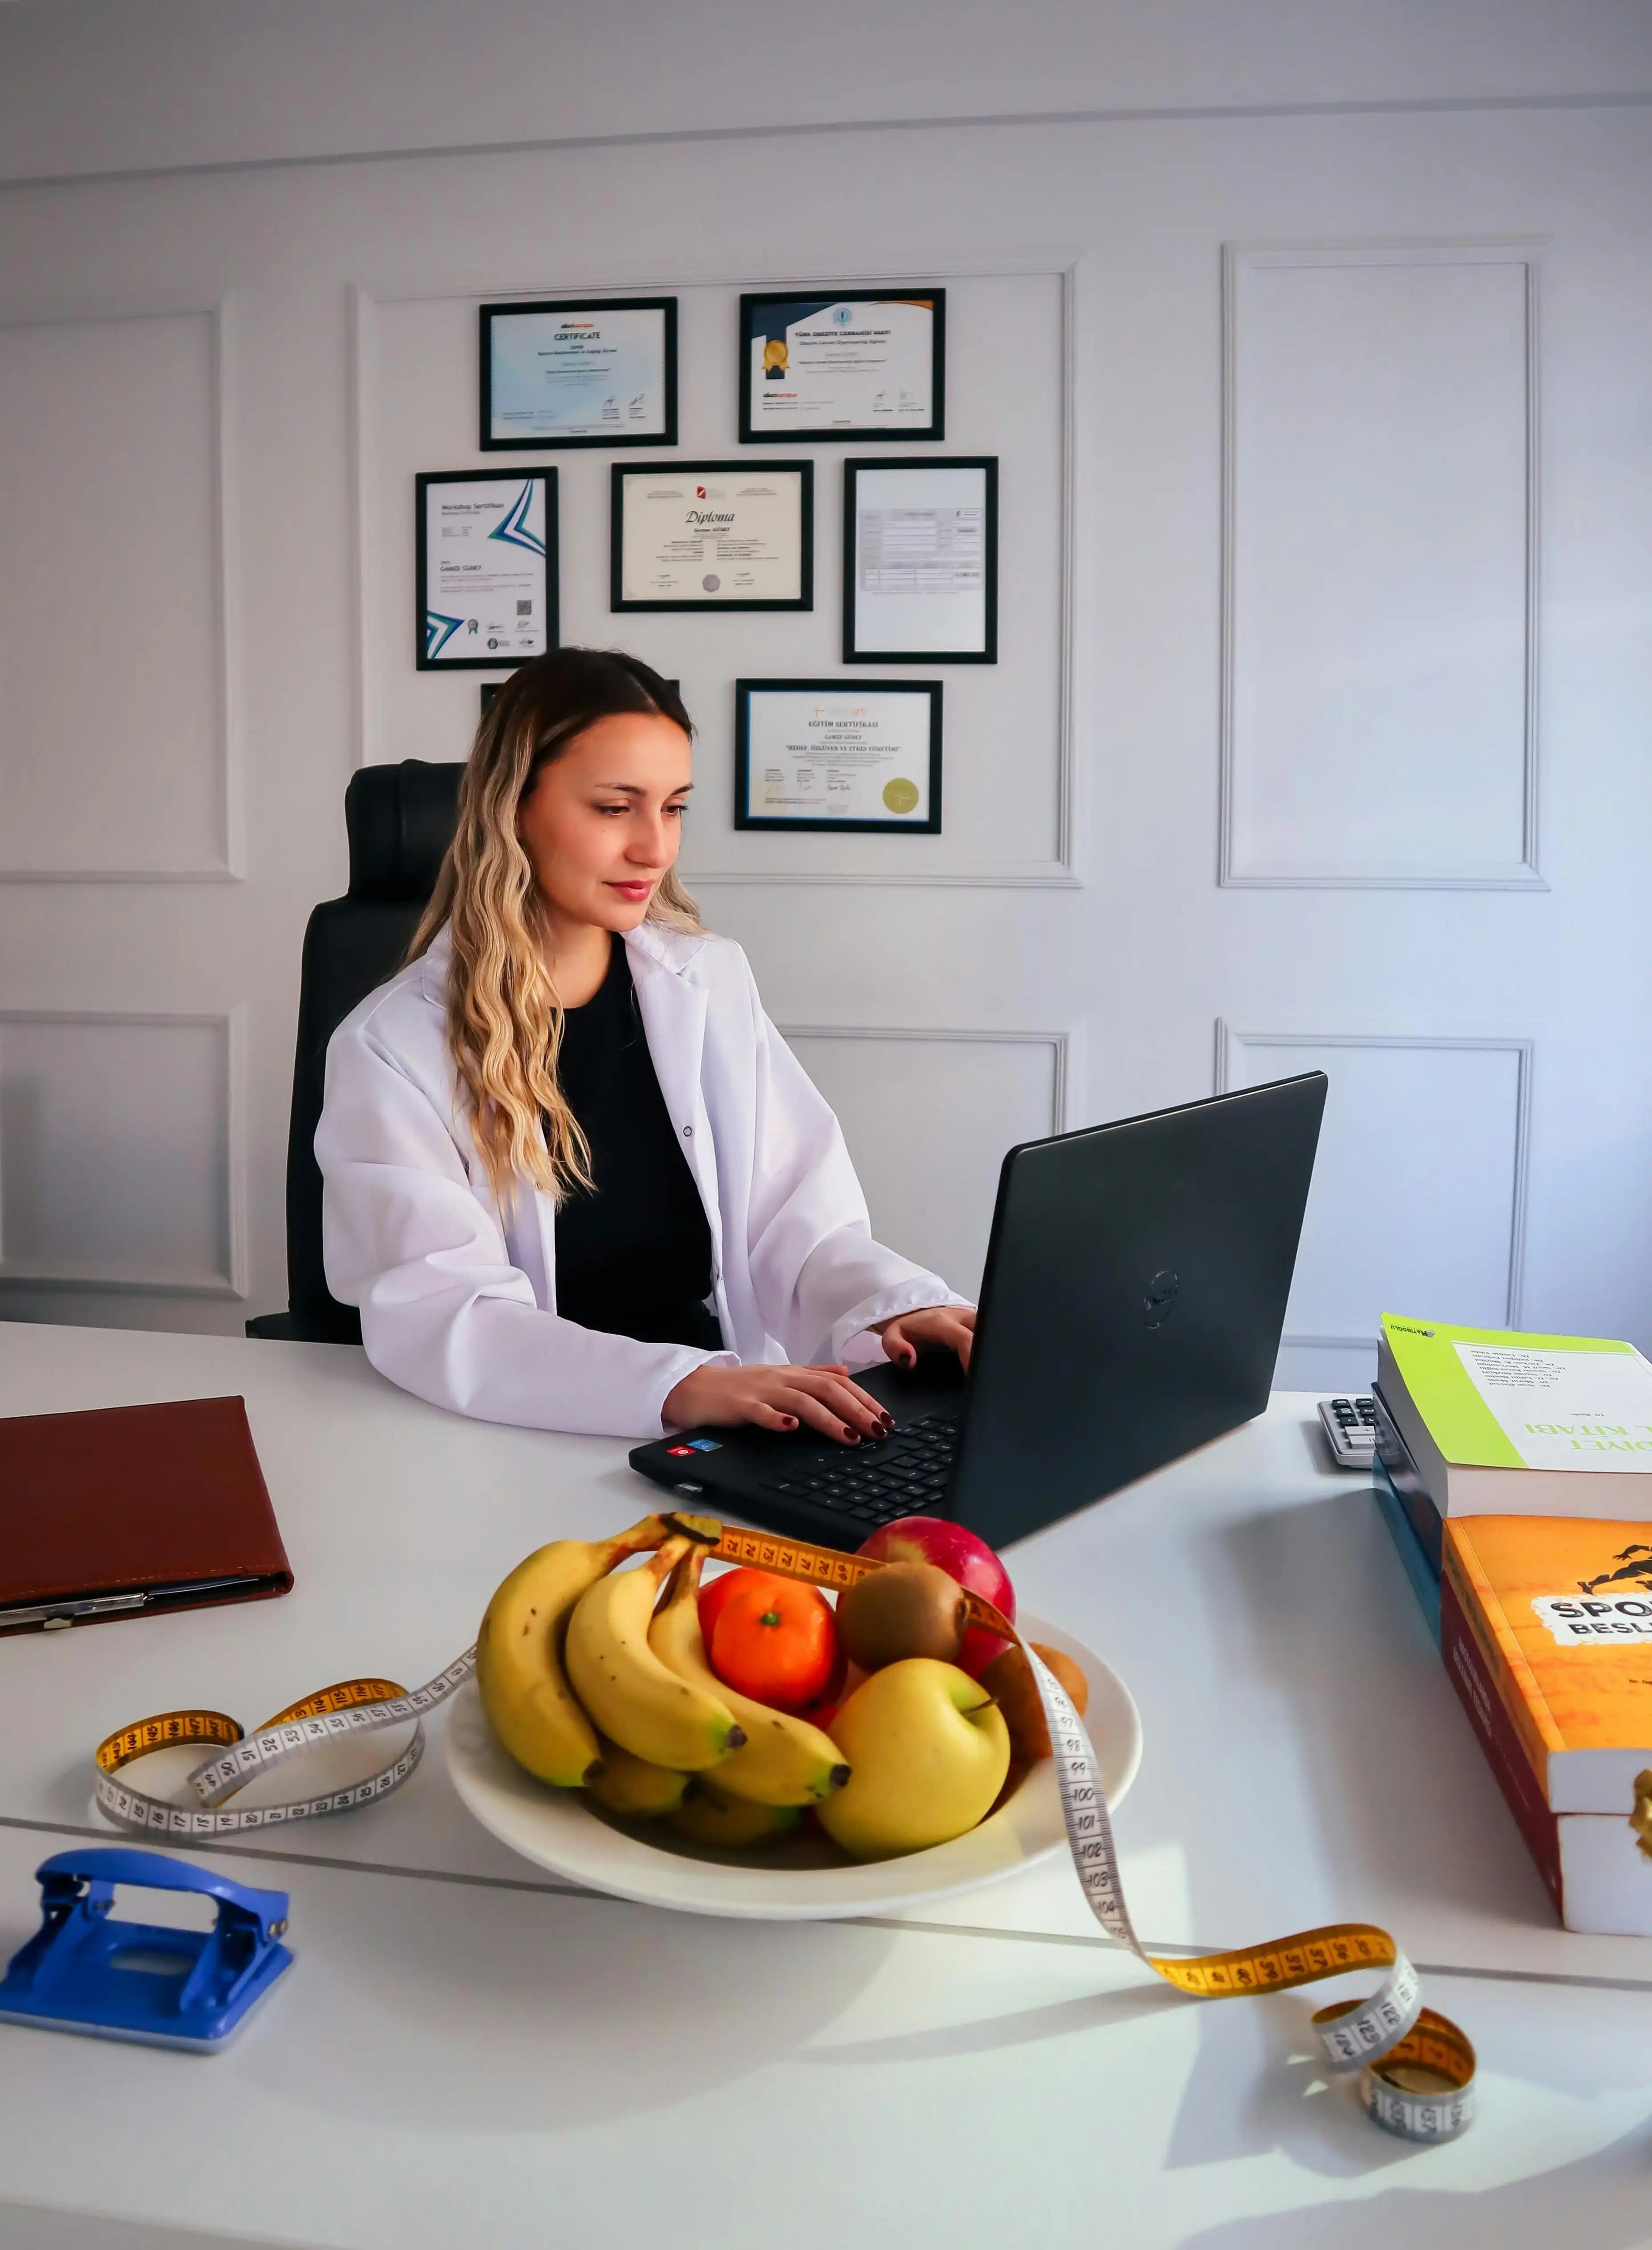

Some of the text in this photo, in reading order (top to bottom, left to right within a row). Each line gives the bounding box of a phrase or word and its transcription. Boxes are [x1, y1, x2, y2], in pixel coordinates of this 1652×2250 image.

[686, 511, 735, 525] Diploma
[1524, 1423, 1629, 1437] KİTABI
[800, 1557, 811, 1570] 71
[819, 1560, 830, 1575] 70
[1551, 1601, 1652, 1618] SPO
[1567, 1622, 1652, 1634] BESL
[313, 1698, 328, 1713] 114
[334, 1691, 348, 1704] 115
[1061, 1716, 1074, 1728] 97
[221, 1762, 235, 1776] 50
[241, 1750, 256, 1761] 51
[263, 1738, 278, 1751] 52
[284, 1730, 300, 1743] 53
[308, 1723, 323, 1734] 54
[329, 1718, 345, 1728] 55
[353, 1713, 365, 1722] 56
[370, 1709, 387, 1718] 57
[391, 1703, 407, 1712] 58
[1067, 1739, 1081, 1752] 98
[1071, 1762, 1086, 1776] 99
[1074, 1788, 1093, 1801] 100
[134, 1804, 144, 1818] 15
[152, 1810, 164, 1824] 16
[174, 1815, 186, 1827] 17
[197, 1817, 210, 1828] 18
[220, 1816, 233, 1826] 19
[1078, 1815, 1095, 1830] 101
[1083, 1842, 1102, 1857] 102
[1089, 1872, 1108, 1887] 103
[1381, 2002, 1400, 2025] 122
